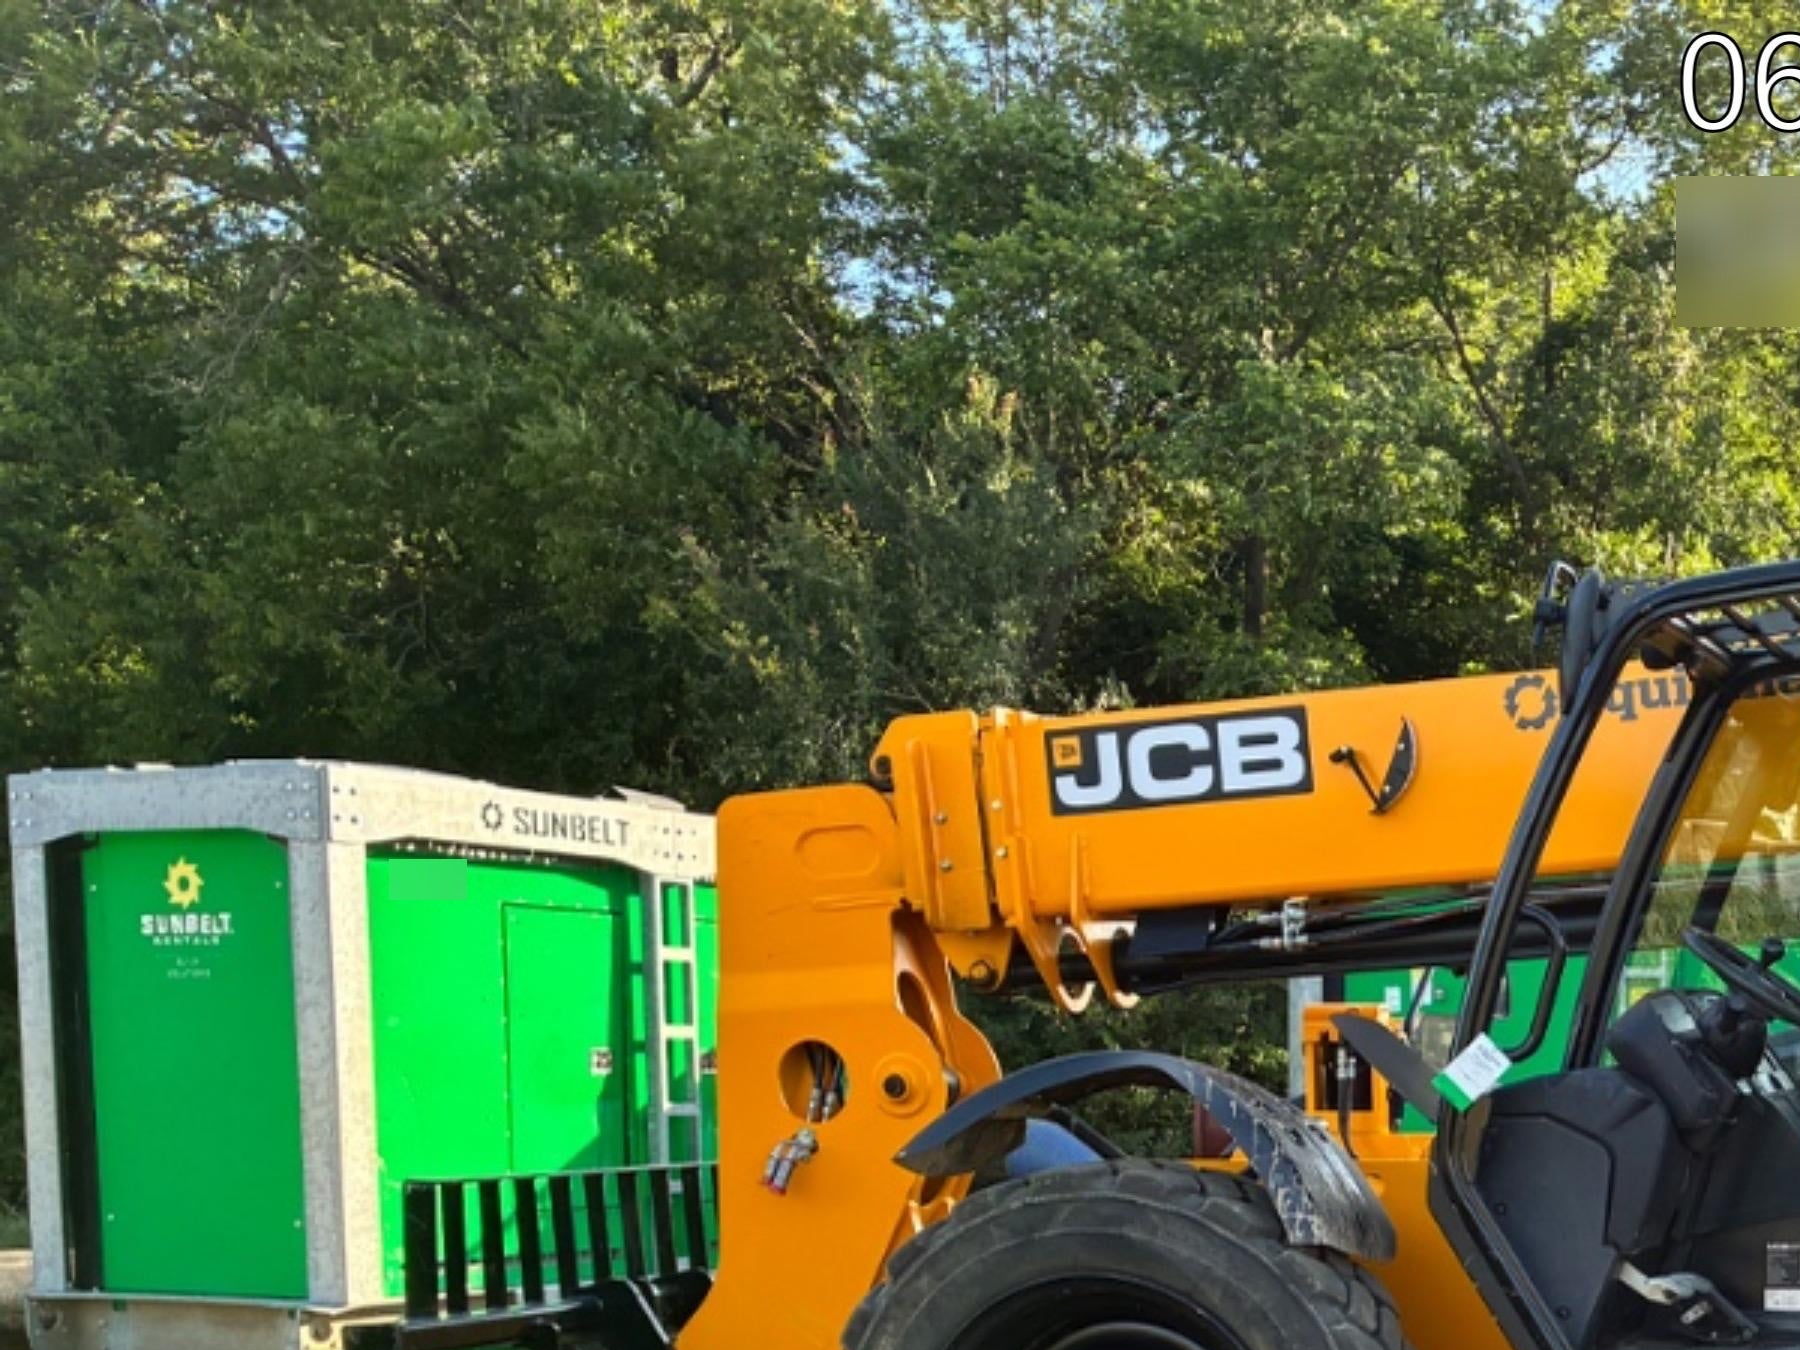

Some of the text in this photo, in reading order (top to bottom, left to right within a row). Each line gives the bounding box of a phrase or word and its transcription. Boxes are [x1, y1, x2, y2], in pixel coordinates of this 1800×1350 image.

[1055, 716, 1305, 807] JCB
[513, 806, 630, 848] SUNBELT
[140, 911, 233, 936] SUNBELT
